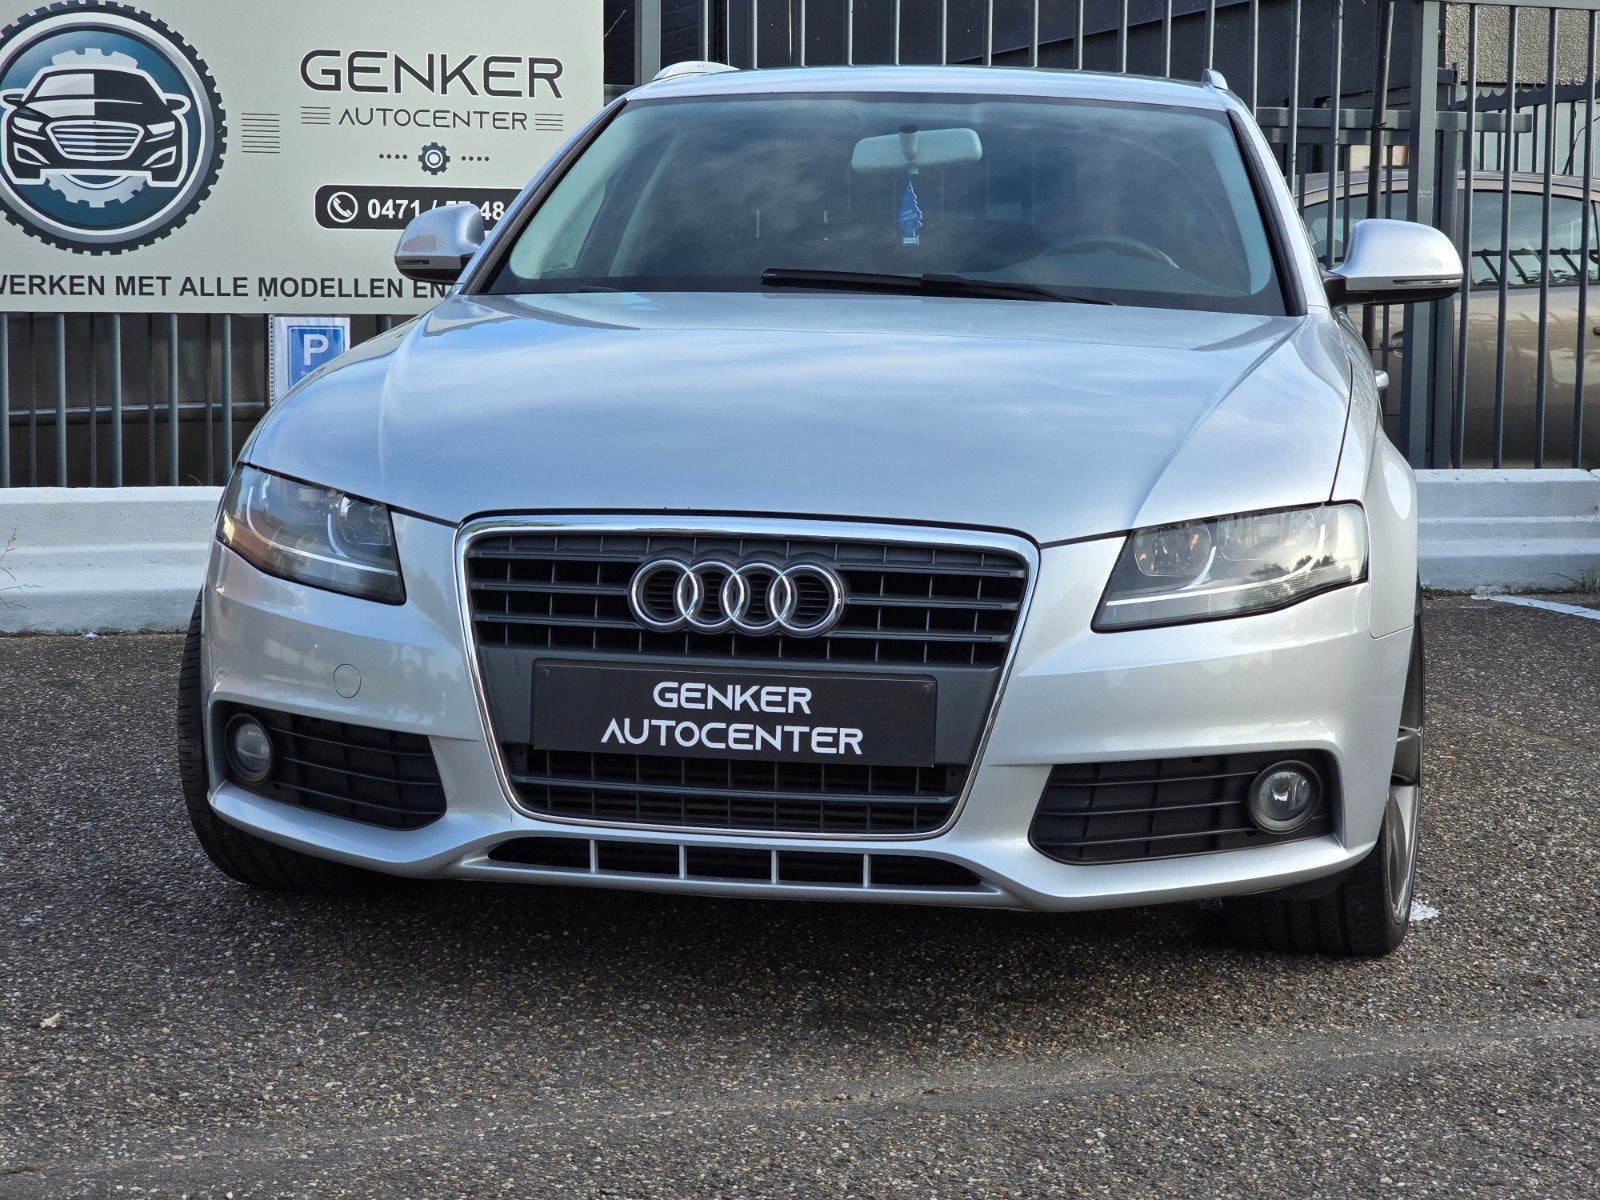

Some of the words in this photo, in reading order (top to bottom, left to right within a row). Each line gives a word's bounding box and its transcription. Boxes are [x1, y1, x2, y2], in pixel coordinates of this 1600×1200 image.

[300, 49, 563, 98] GENKER
[338, 107, 527, 130] AUTOCENTER
[367, 199, 420, 219] 0471
[115, 275, 172, 296] MET
[179, 276, 249, 297] ALLE
[258, 276, 403, 298] MODELLEN
[413, 280, 446, 299] EN
[303, 333, 329, 366] P
[652, 681, 812, 714] GENKER
[600, 717, 864, 755] AUTOCENTER
